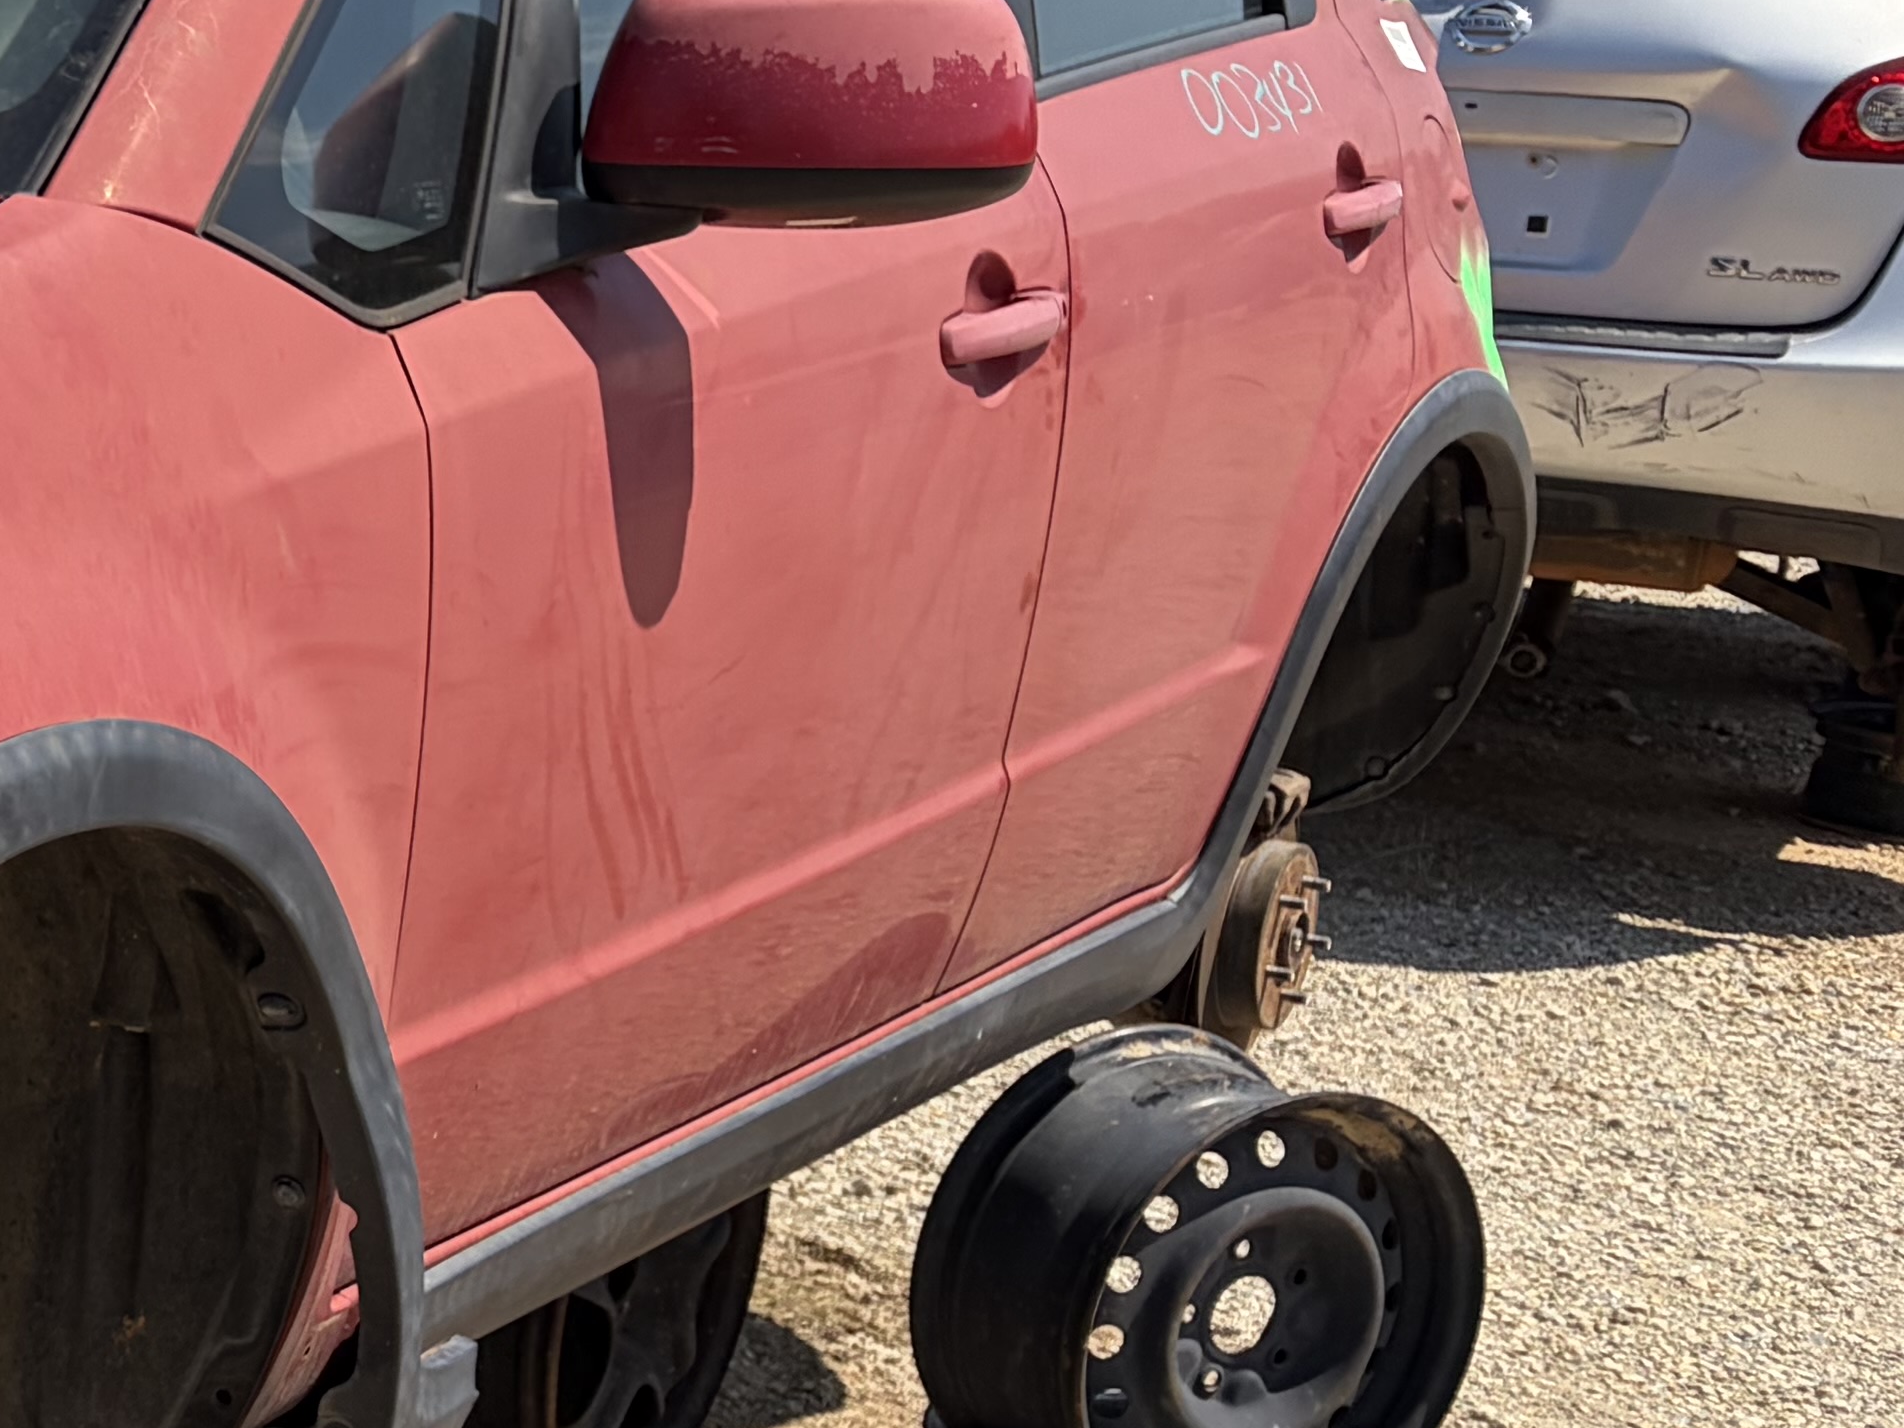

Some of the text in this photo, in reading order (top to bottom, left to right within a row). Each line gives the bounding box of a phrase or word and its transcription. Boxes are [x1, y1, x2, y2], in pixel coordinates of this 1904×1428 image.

[1180, 60, 1324, 139] 003431
[1707, 256, 1841, 285] SL AWD
